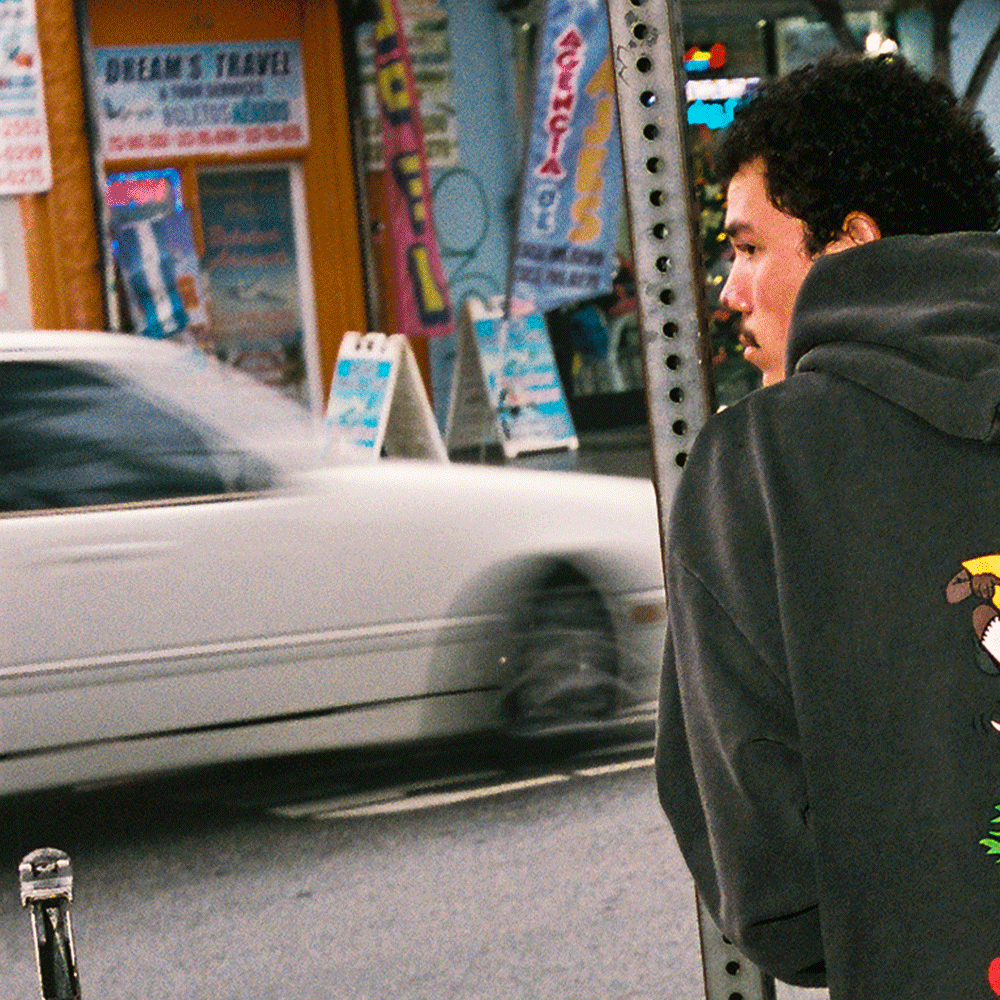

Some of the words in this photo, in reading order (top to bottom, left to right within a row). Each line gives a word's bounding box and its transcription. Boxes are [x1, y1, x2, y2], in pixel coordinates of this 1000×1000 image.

[105, 54, 202, 85] DREAM'S
[215, 50, 291, 79] TRAVEL
[533, 26, 586, 179] AGENCIA
[567, 55, 614, 244] AJES
